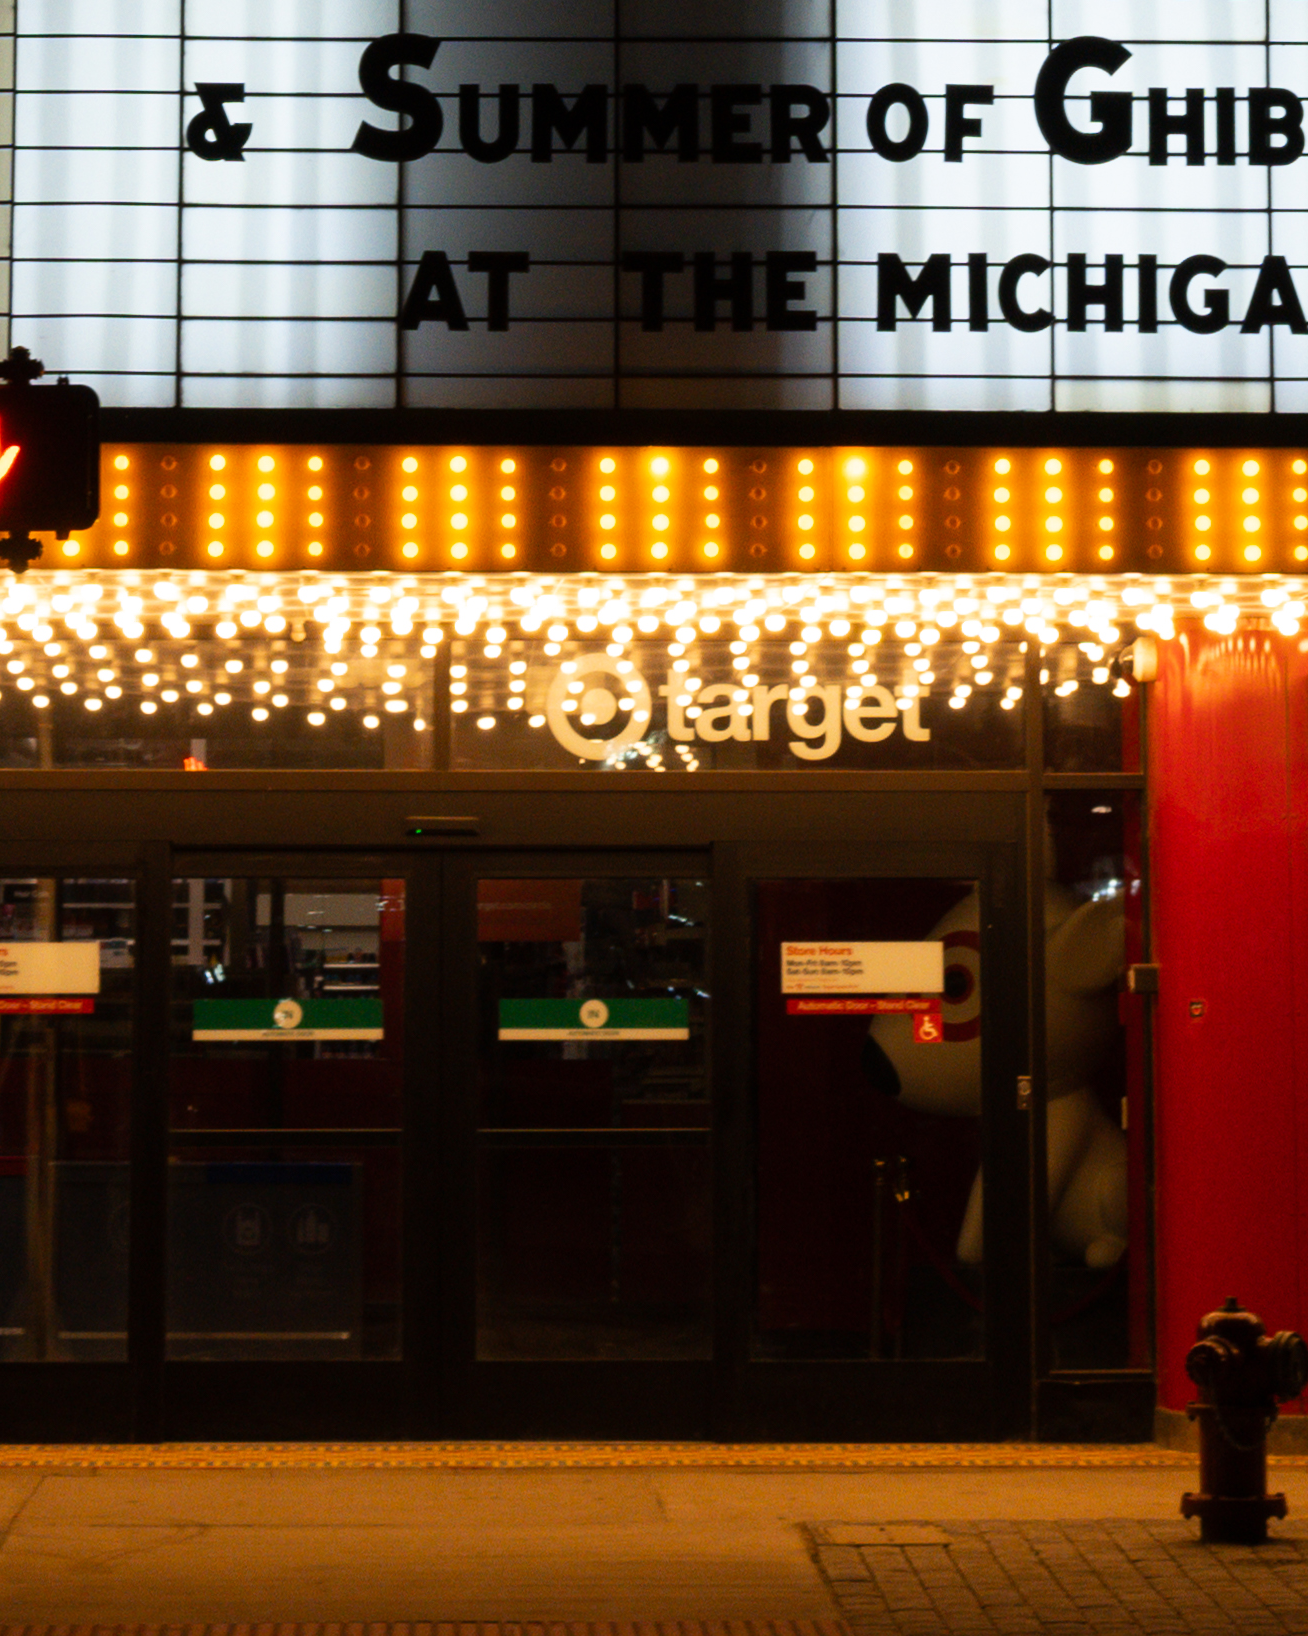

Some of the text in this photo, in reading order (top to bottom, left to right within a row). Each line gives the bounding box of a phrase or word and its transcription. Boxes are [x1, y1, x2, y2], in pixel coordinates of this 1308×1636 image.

[185, 82, 253, 162] &
[866, 83, 996, 163] OF
[397, 251, 530, 330] AT
[623, 251, 819, 330] THE
[659, 668, 931, 761] target
